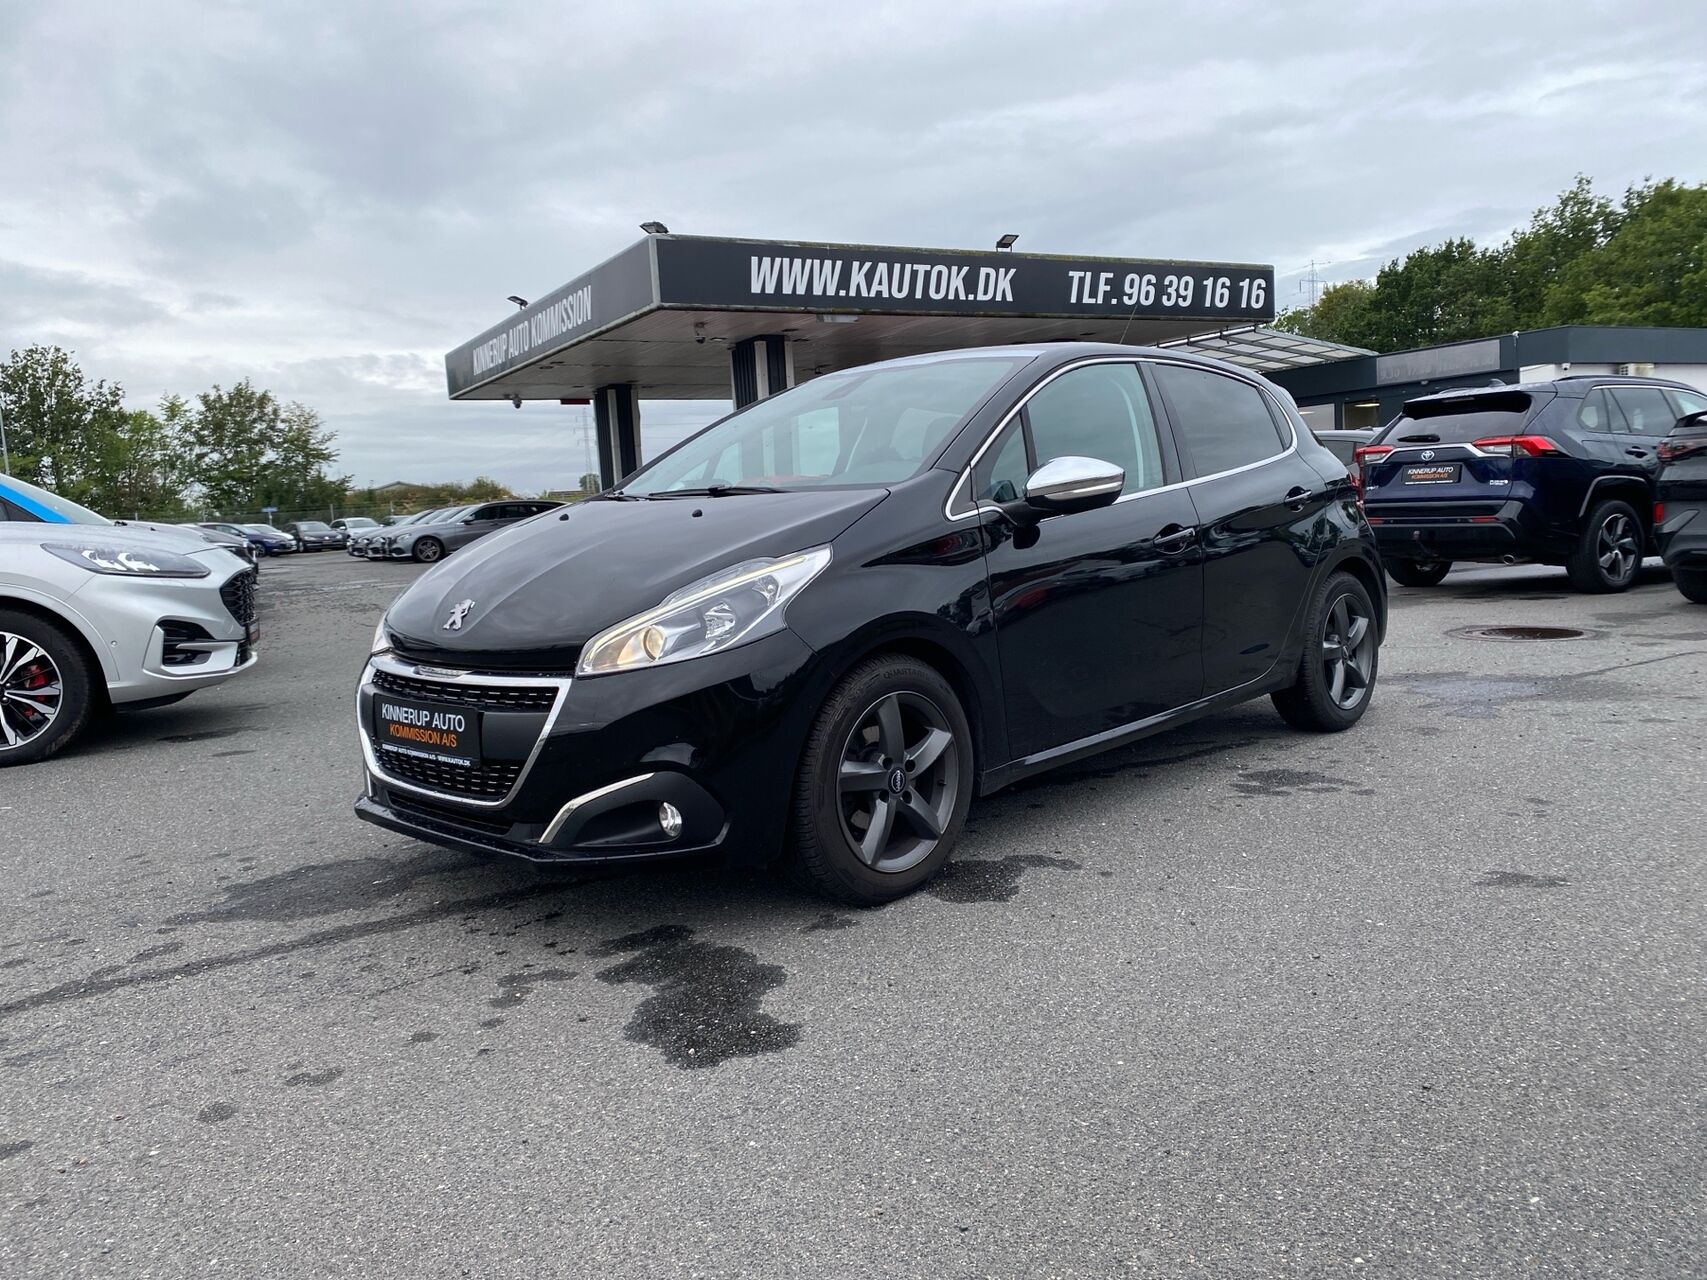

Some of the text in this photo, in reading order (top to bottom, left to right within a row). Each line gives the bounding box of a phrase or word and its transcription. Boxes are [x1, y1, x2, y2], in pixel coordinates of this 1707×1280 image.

[750, 256, 1017, 302] WWW.KAUTOK.DK
[1068, 270, 1267, 309] TLF. 96 39 16 16
[473, 285, 591, 376] KINNERUP AUTO KOMMISSION
[1437, 466, 1454, 474] AUTO
[382, 703, 465, 732] KINNERUP AUTO
[390, 724, 457, 747] KOMMISSION A/S
